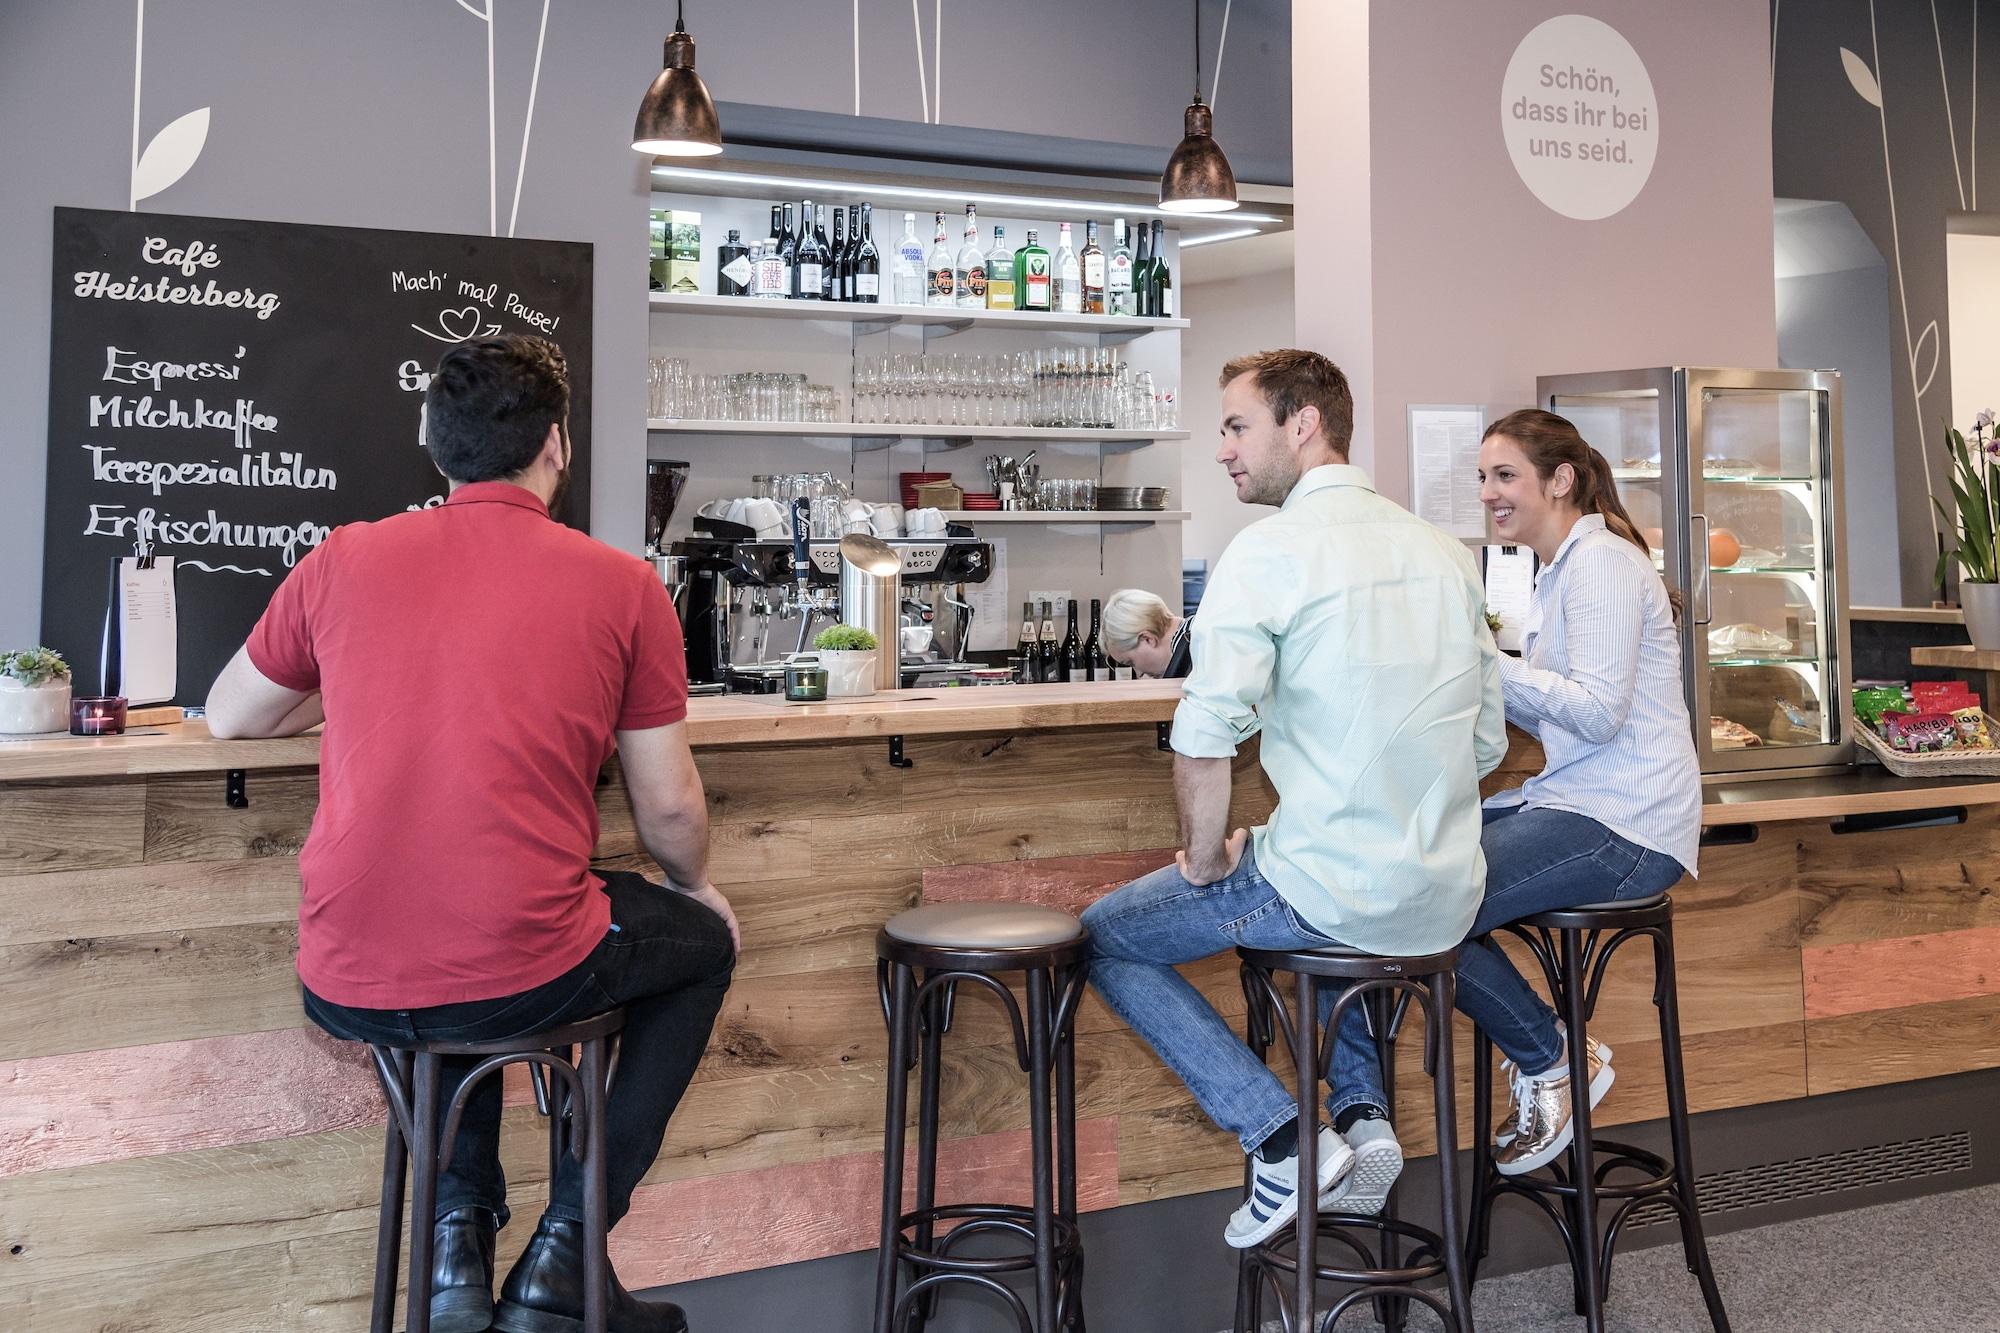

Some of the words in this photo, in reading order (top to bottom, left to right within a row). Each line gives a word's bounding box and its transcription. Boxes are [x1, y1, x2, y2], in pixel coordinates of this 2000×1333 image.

[1539, 64, 1620, 98] Schön,
[1512, 96, 1568, 124] dass
[1574, 101, 1606, 127] ihr
[1612, 105, 1647, 131] bei
[1529, 138, 1572, 159] uns
[1578, 138, 1633, 164] seid.
[142, 237, 221, 277] Café
[74, 271, 281, 320] Heisterberg
[458, 280, 497, 308] mal
[503, 293, 560, 335] Pause!
[89, 395, 278, 448] Milchkaffee
[1904, 718, 1948, 733] HARIBO
